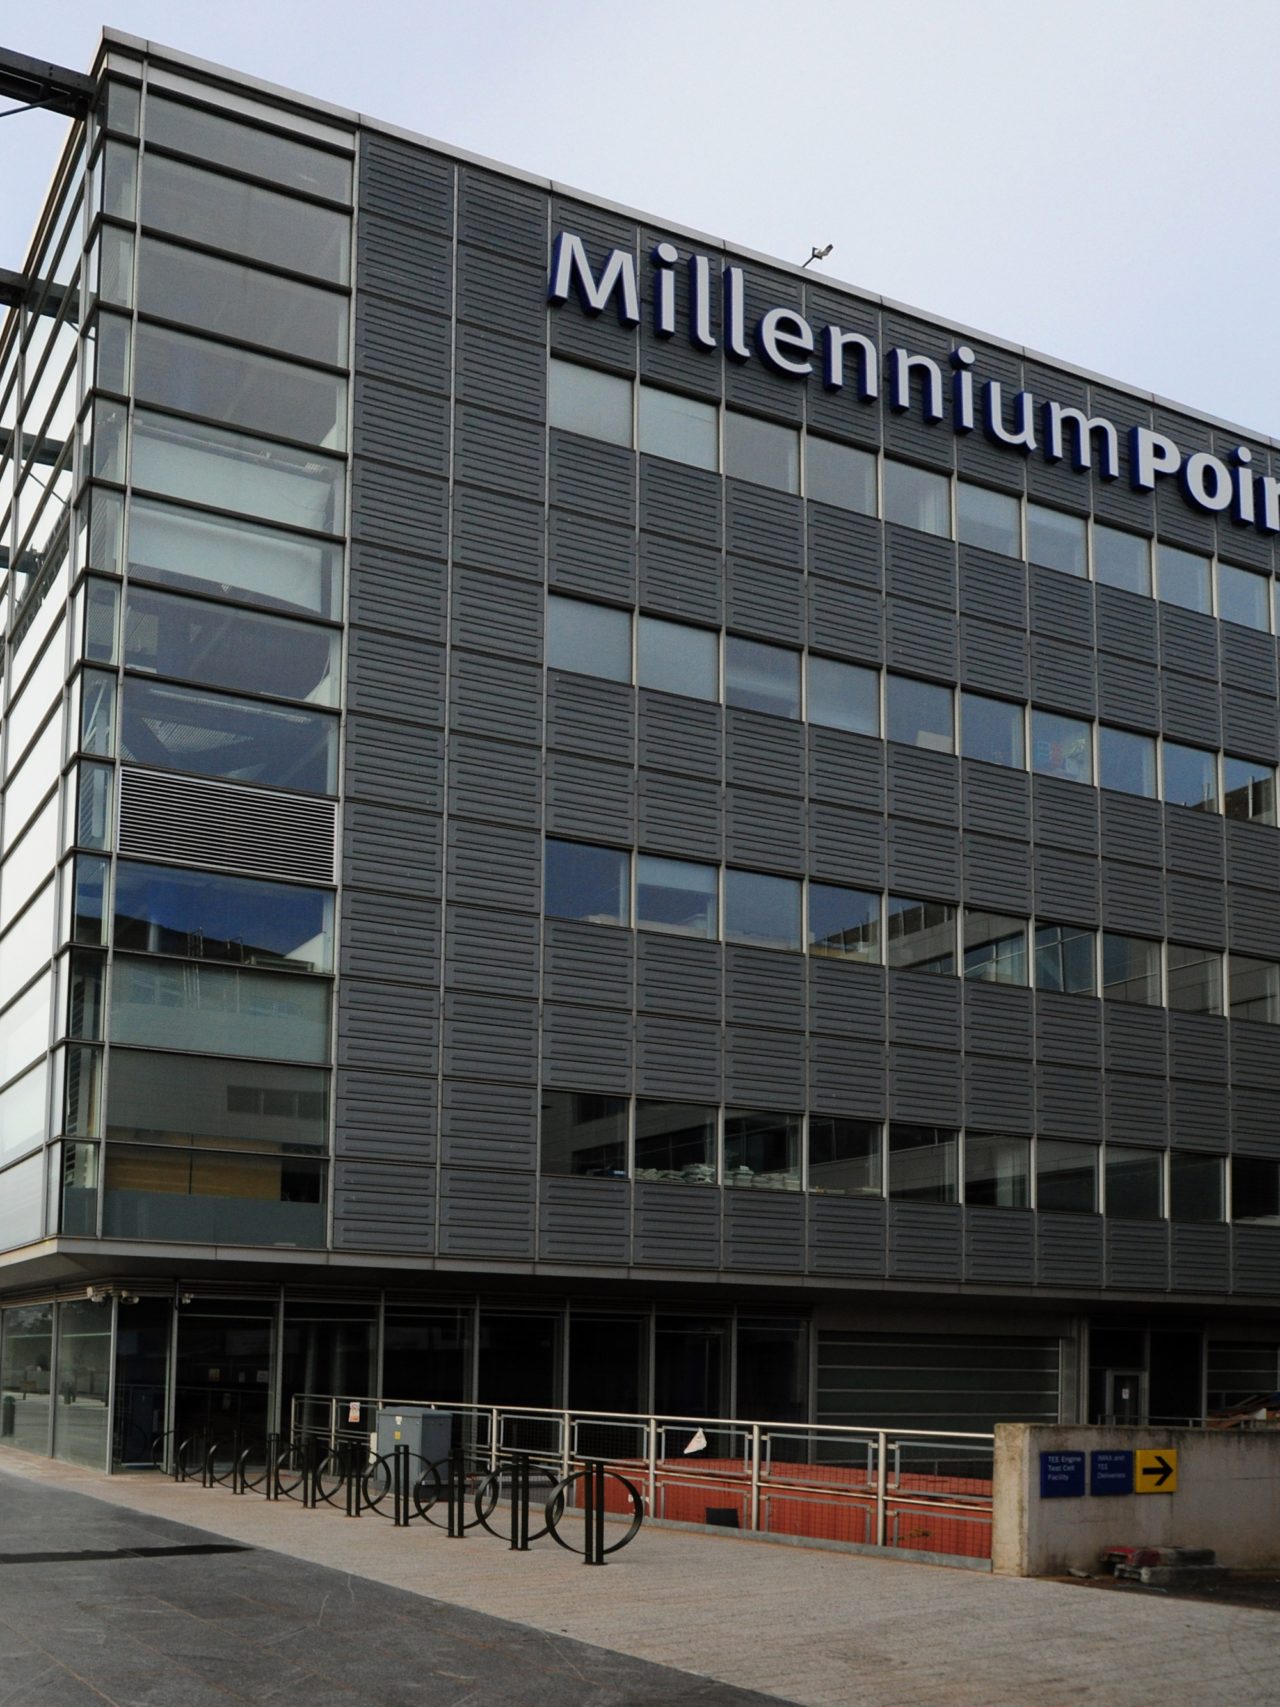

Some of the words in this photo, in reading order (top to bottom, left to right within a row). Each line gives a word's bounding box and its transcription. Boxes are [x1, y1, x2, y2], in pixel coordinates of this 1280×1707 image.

[549, 230, 1119, 482] Millennium
[1061, 1455, 1082, 1464] Engine
[1048, 1464, 1061, 1472] Test
[1048, 1474, 1069, 1482] Facility
